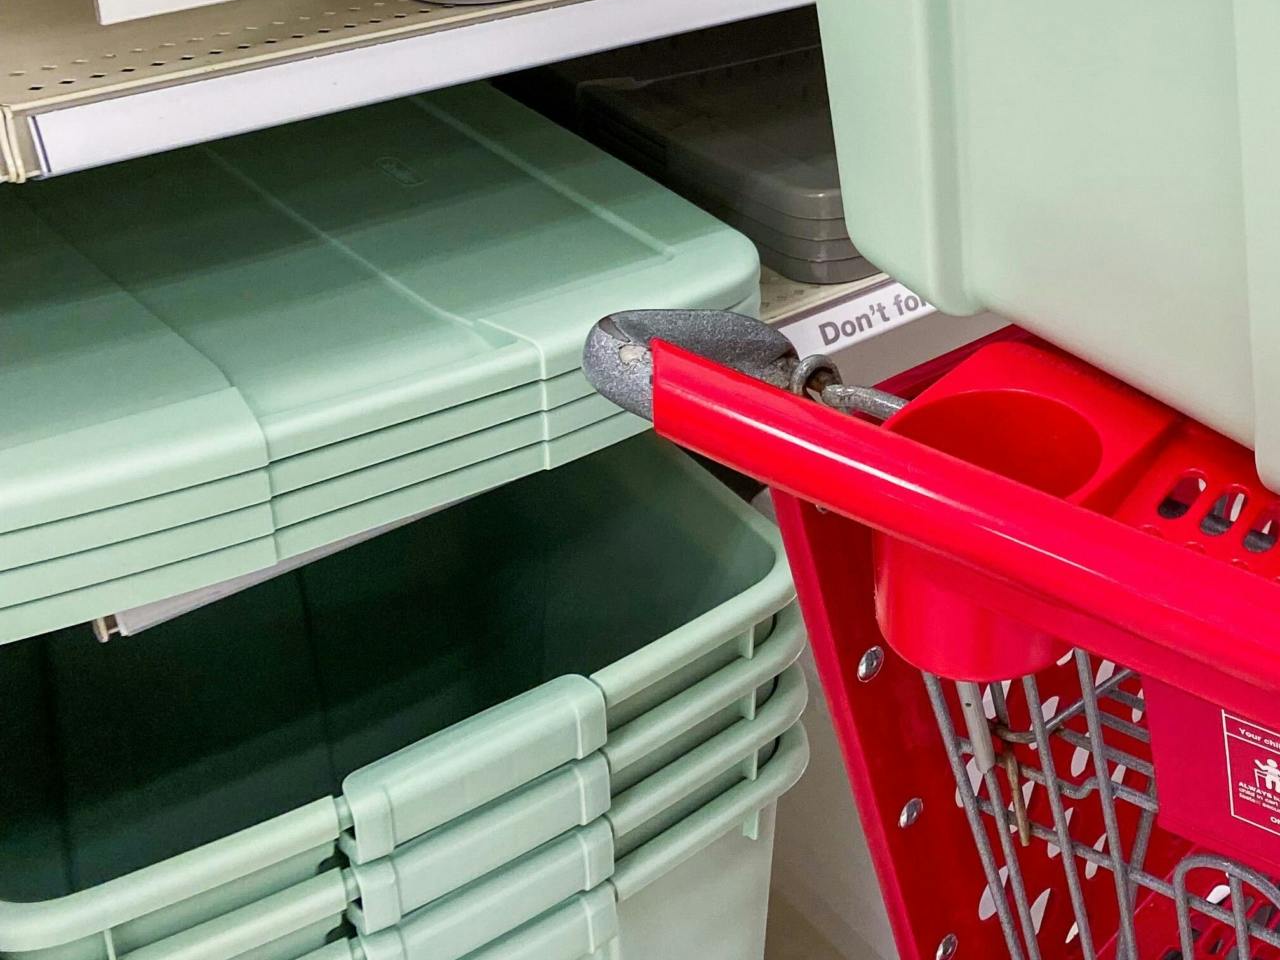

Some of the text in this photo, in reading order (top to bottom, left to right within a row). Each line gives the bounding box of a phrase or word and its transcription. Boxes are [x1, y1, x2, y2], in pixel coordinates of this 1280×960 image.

[818, 293, 927, 346] Don't fo
[1239, 727, 1262, 741] Your
[1238, 781, 1273, 799] ALWAYS
